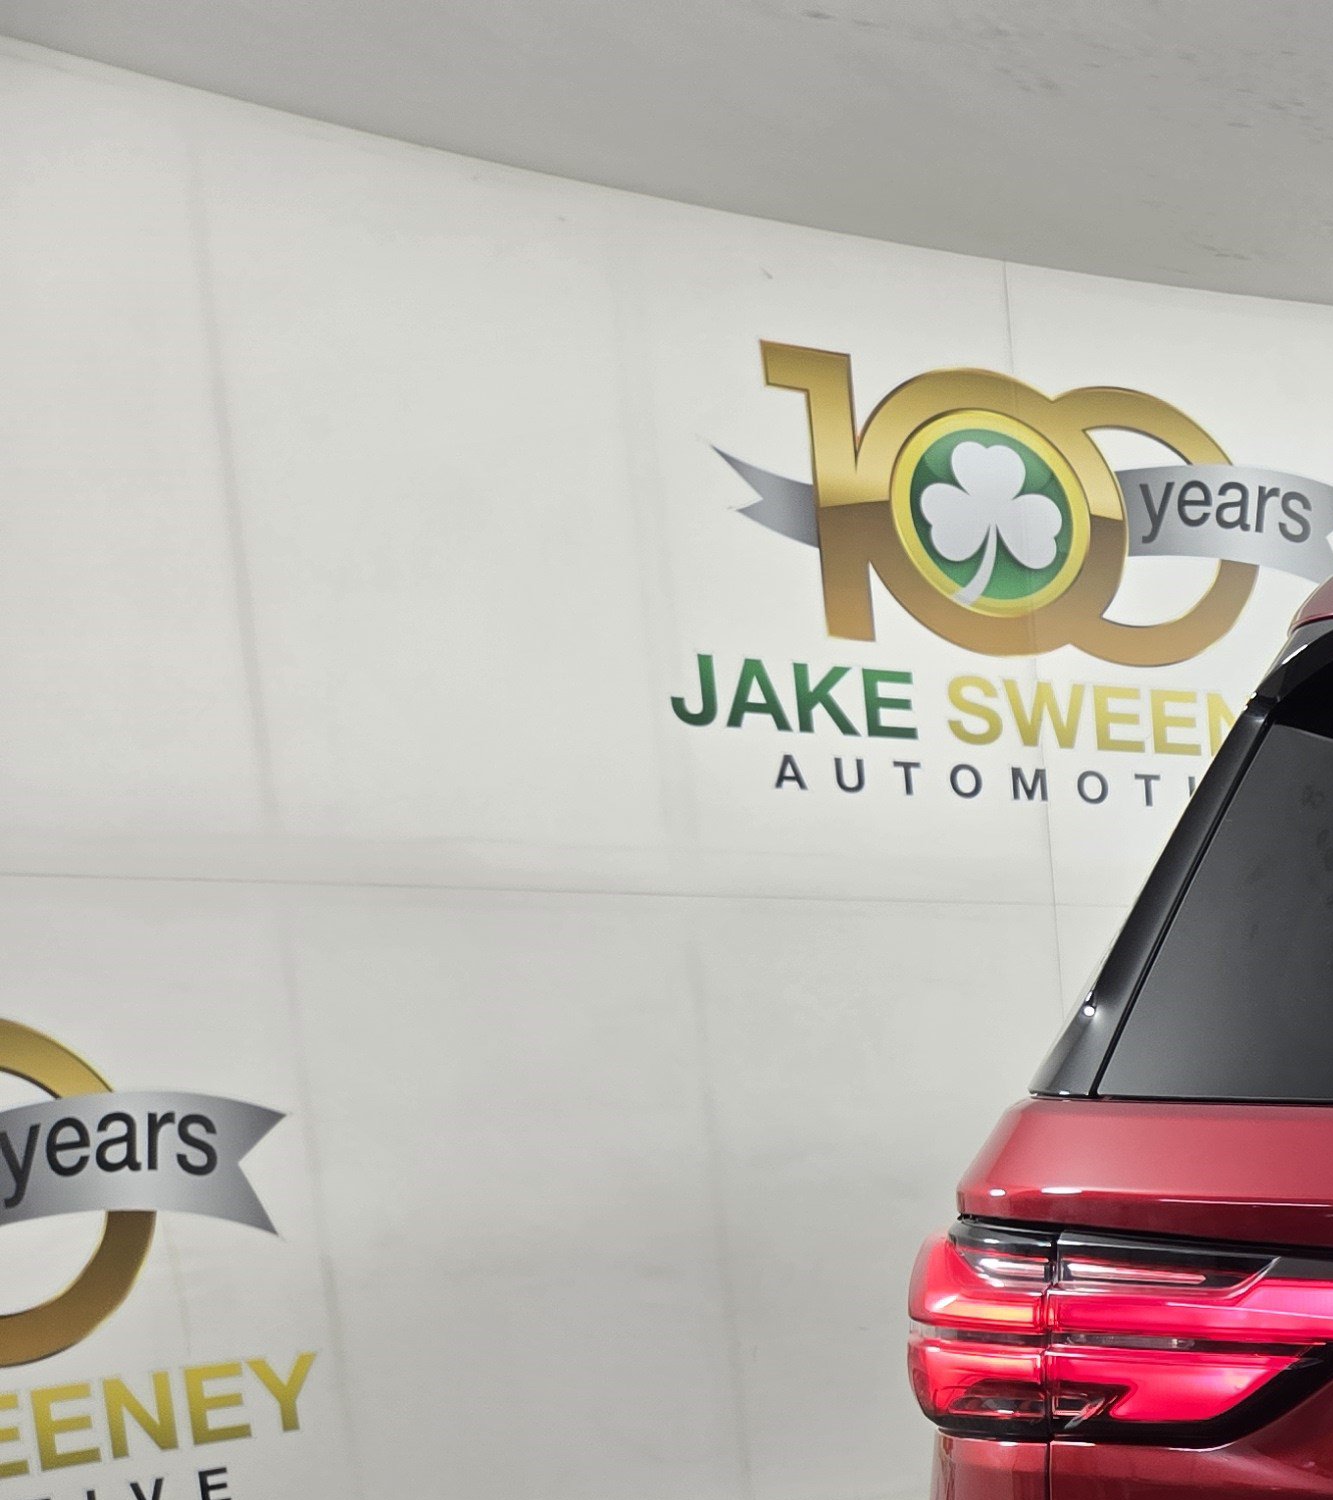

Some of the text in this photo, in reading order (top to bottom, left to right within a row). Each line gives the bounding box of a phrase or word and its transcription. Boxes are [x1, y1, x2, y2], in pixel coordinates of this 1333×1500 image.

[760, 340, 1313, 666] 100 years
[671, 654, 919, 740] JAKE
[0, 1112, 218, 1208] years
